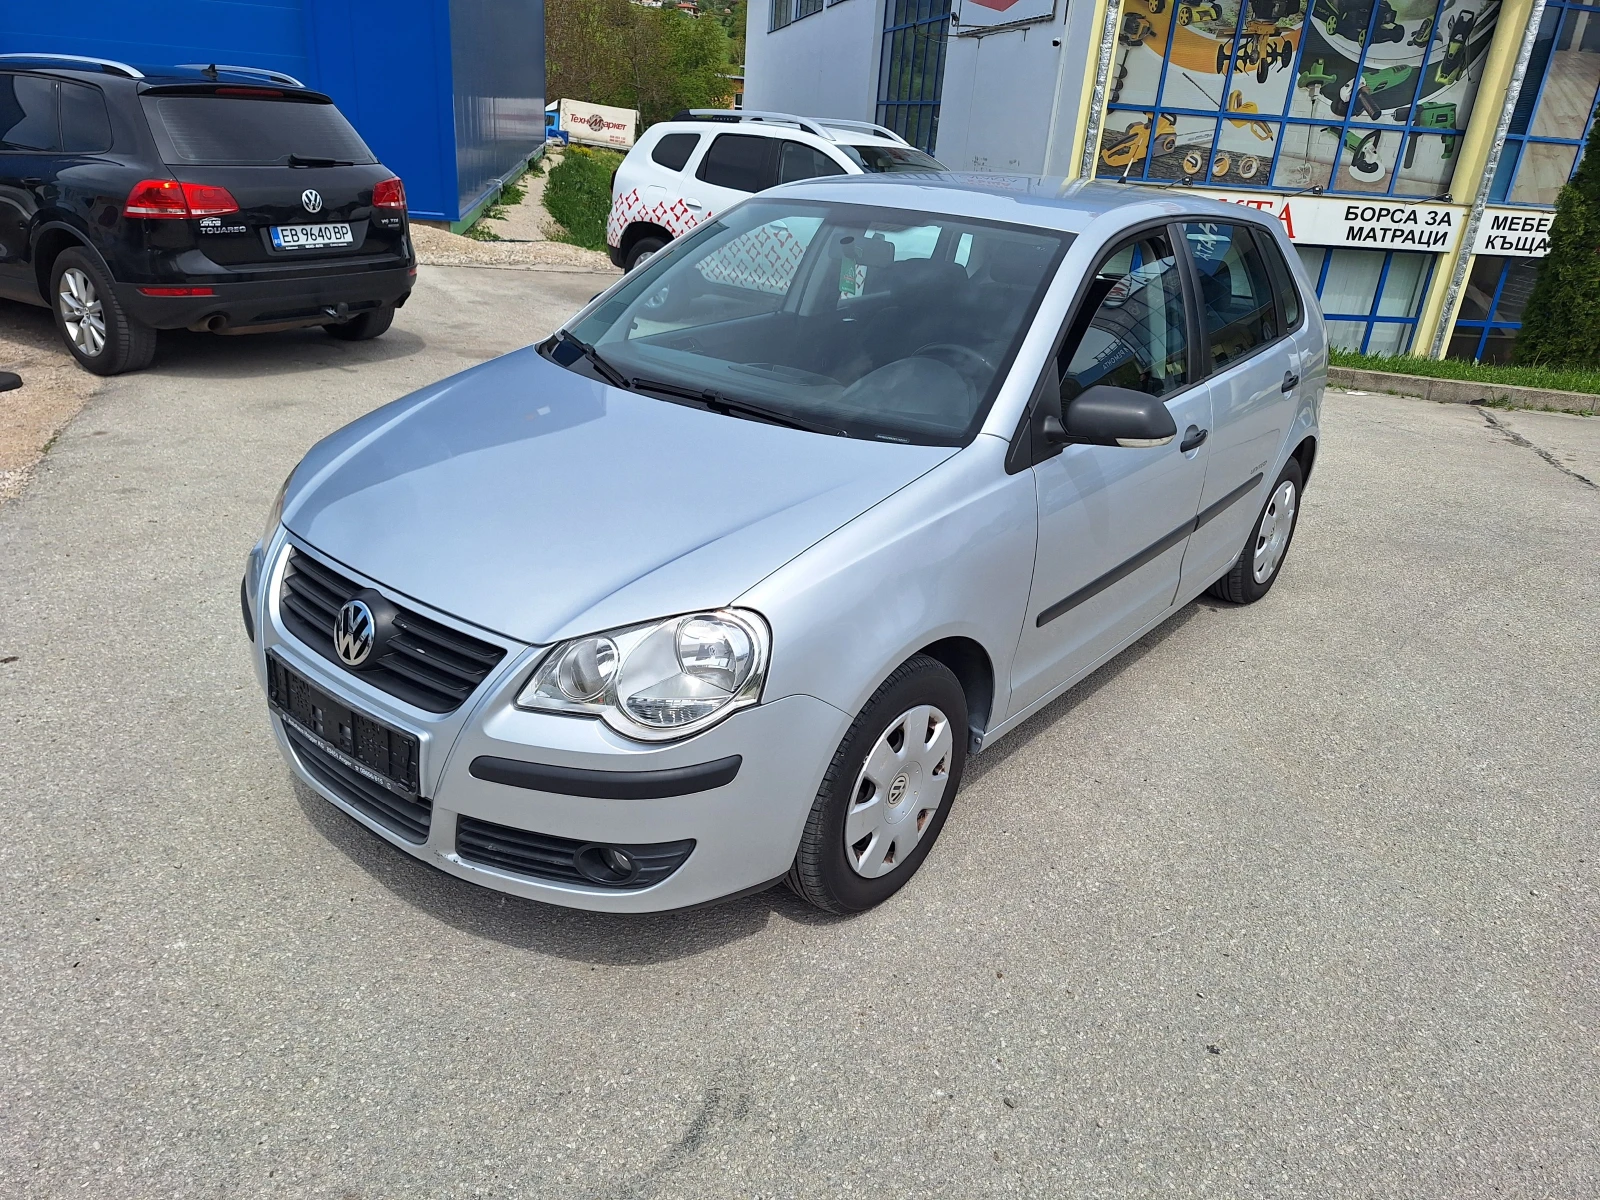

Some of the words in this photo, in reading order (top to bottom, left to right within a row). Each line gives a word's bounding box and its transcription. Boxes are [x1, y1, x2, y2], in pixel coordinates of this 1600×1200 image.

[1344, 205, 1419, 226] БОРСА
[1424, 210, 1453, 227] ЗА
[200, 226, 247, 234] TOUAREG
[281, 228, 300, 243] EB
[301, 226, 332, 242] 9640
[333, 225, 349, 240] BP
[1345, 226, 1449, 249] МАТРАЦИ
[1485, 234, 1549, 255] КЪЩА
